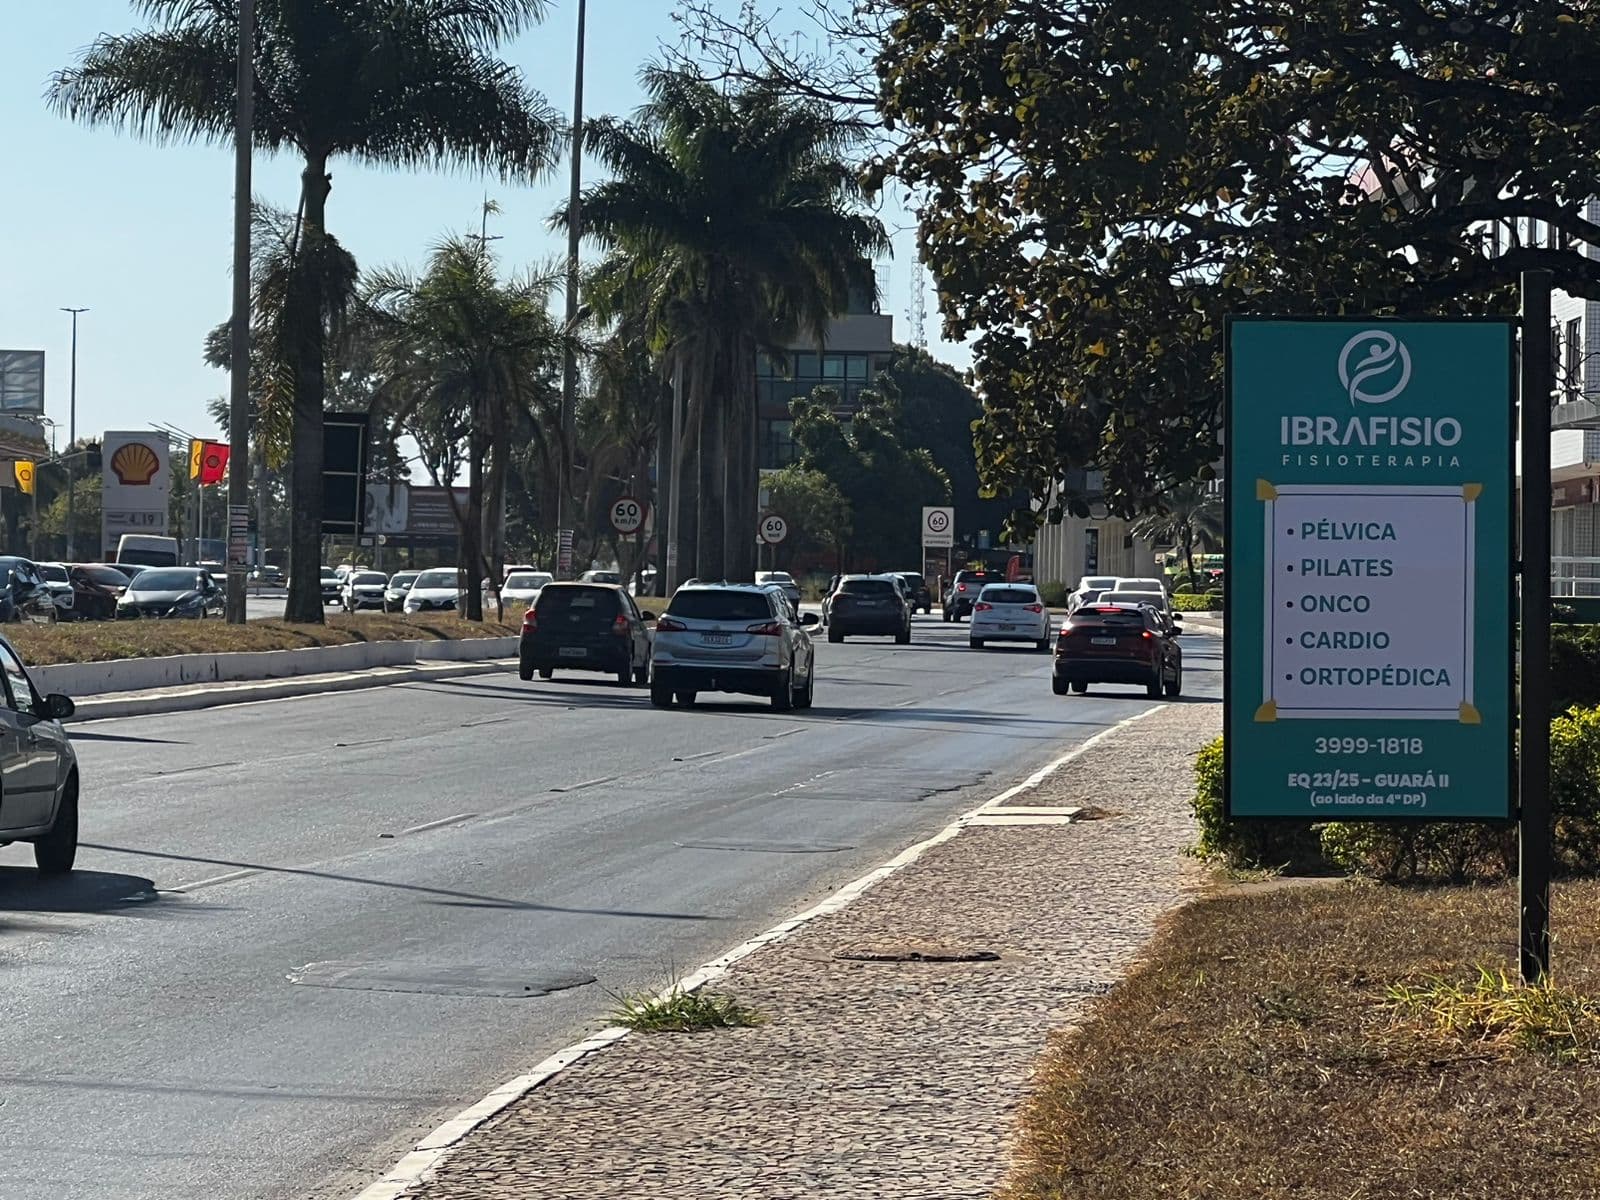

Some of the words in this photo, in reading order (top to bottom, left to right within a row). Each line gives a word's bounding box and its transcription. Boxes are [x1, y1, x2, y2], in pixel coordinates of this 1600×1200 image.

[1280, 416, 1462, 447] IBRAFISIO
[1282, 454, 1460, 467] FISIOTERAPIA
[616, 503, 637, 516] 60
[615, 517, 638, 526] km/h
[766, 520, 783, 531] 60
[932, 517, 944, 525] 60
[1301, 518, 1397, 541] PÉLVICA
[1301, 558, 1394, 577] PILATES
[1300, 594, 1370, 613] ONCO
[1300, 631, 1390, 650] CARDIO
[1300, 664, 1451, 687] ORTOPÉDICA
[1315, 737, 1423, 755] 3999-1818
[1288, 773, 1311, 789] EQ
[1313, 769, 1360, 790] 23/25
[1375, 769, 1437, 788] GUARÁ
[1439, 774, 1449, 788] II
[1310, 791, 1334, 808] (ao
[1335, 793, 1365, 805] lado
[1366, 793, 1384, 805] da
[1403, 792, 1427, 808] DP)
